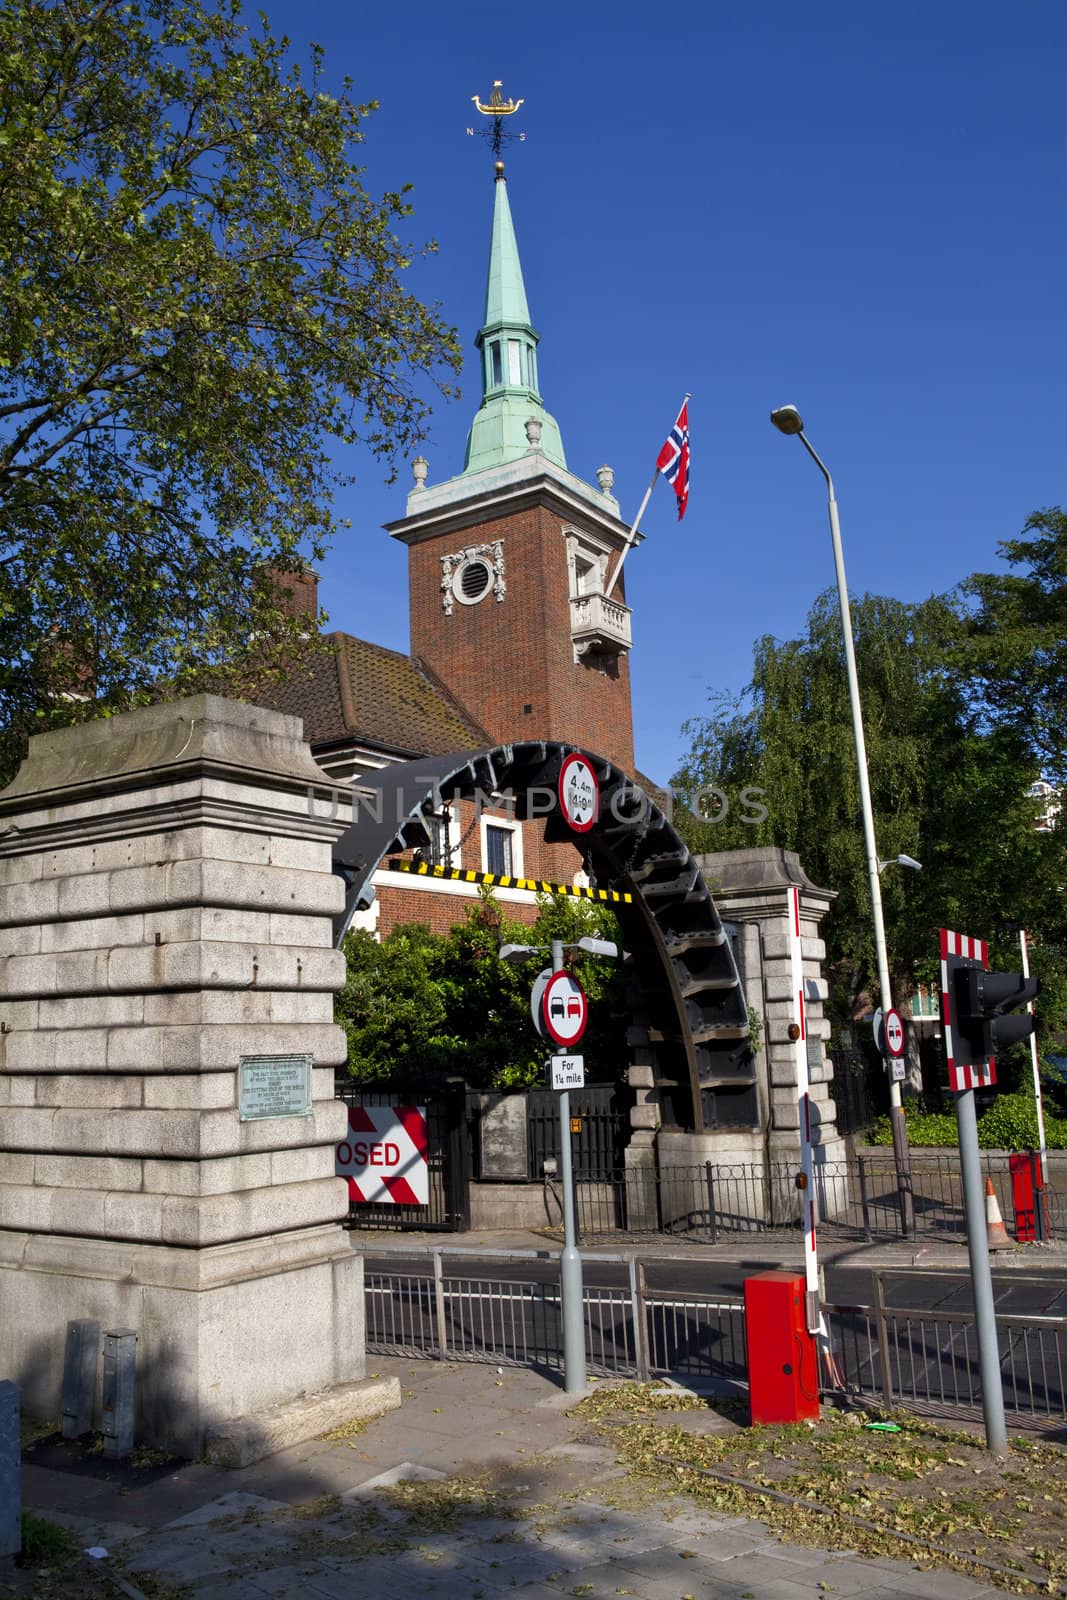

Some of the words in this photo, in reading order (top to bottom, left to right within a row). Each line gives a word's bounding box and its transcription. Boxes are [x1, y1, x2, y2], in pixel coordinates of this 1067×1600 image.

[466, 127, 474, 136] N
[570, 775, 592, 794] 4.4m
[562, 1060, 574, 1070] For
[566, 1073, 582, 1083] mile
[336, 1141, 401, 1166] OSED
